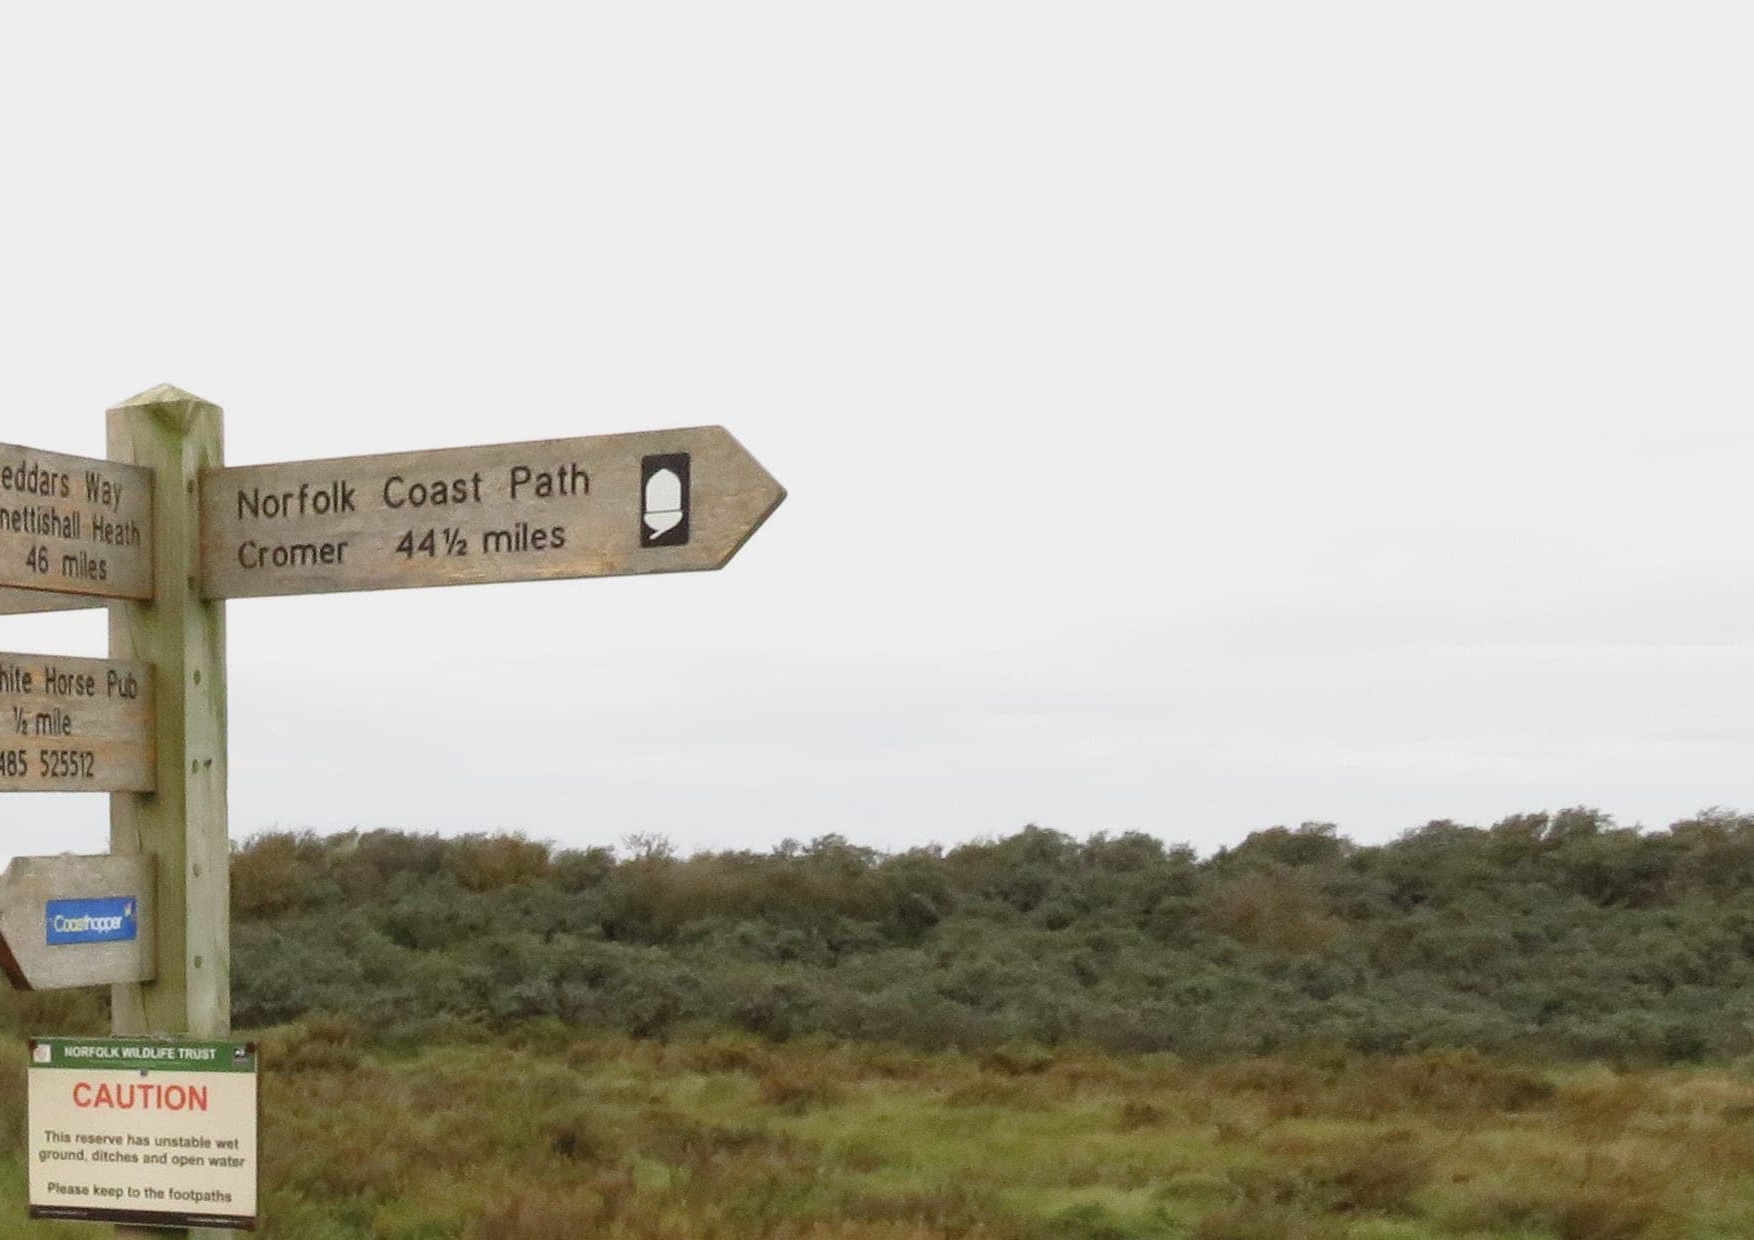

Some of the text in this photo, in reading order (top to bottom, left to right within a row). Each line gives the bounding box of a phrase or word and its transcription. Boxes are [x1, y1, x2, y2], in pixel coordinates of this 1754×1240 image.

[85, 470, 123, 513] Way
[237, 462, 590, 520] Norfolk Coast Path
[92, 514, 141, 546] Heath
[237, 539, 349, 570] Cromer
[482, 522, 566, 553] miles
[26, 545, 108, 580] 46 miles
[45, 665, 95, 697] Horse
[107, 670, 138, 700] Pub
[36, 707, 72, 736] mile
[40, 750, 95, 778] 525512
[63, 1046, 217, 1060] NORFOLK WILDLIFE TRUST
[72, 1081, 209, 1112] CAUTION
[44, 1130, 240, 1150] This reserve has unstable wet
[38, 1149, 247, 1168] ground, ditches and open water
[47, 1182, 233, 1204] Please keep to the footpaths
